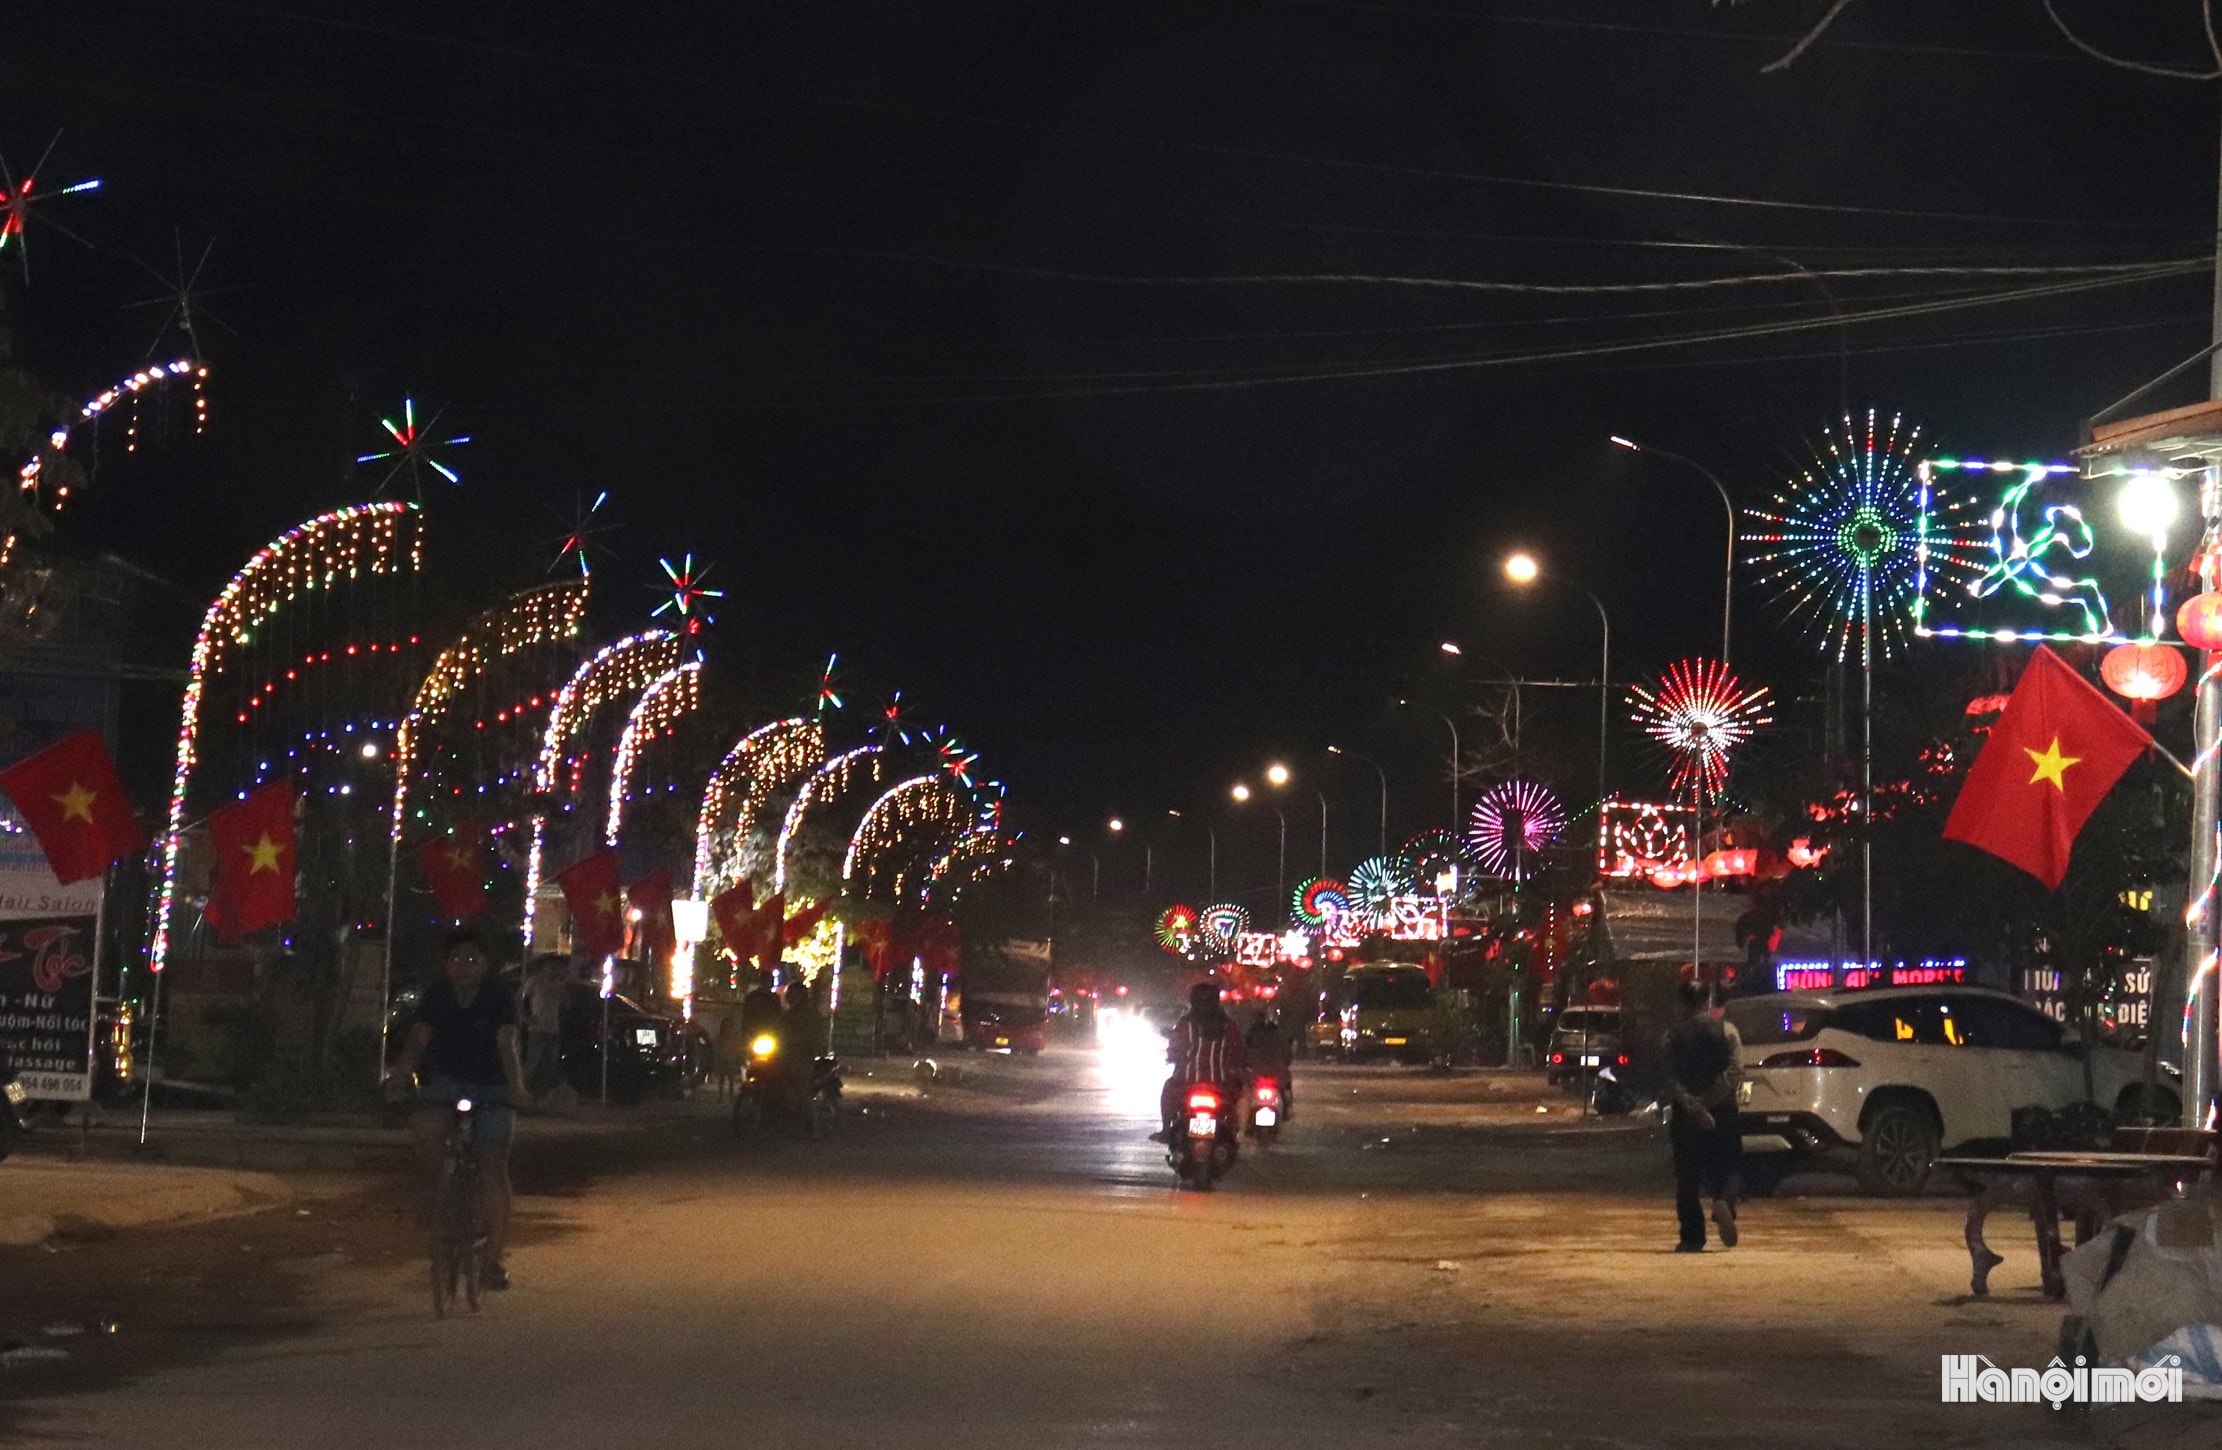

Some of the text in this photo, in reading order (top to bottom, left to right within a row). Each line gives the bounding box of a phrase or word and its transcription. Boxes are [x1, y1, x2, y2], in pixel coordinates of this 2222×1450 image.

[0, 893, 97, 913] air Salon
[2124, 966, 2151, 994] SỬ
[2117, 999, 2151, 1029] ĐIỆ
[8, 1056, 76, 1071] assage
